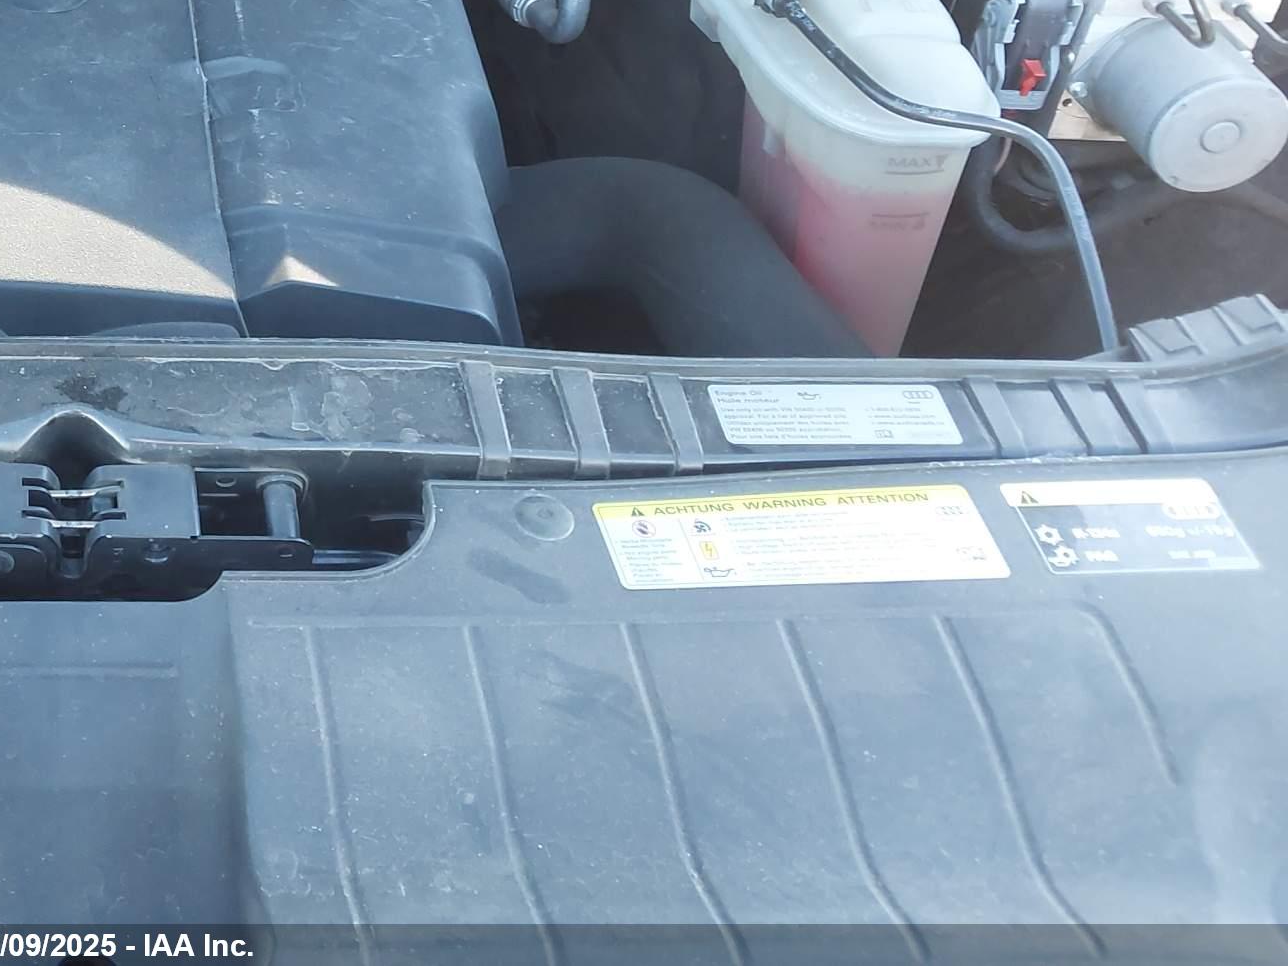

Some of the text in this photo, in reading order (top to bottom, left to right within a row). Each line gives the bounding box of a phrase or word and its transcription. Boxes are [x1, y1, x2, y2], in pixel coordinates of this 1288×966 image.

[887, 157, 931, 168] MAX
[654, 492, 929, 516] ACHTUNG WARNING ATTENTION
